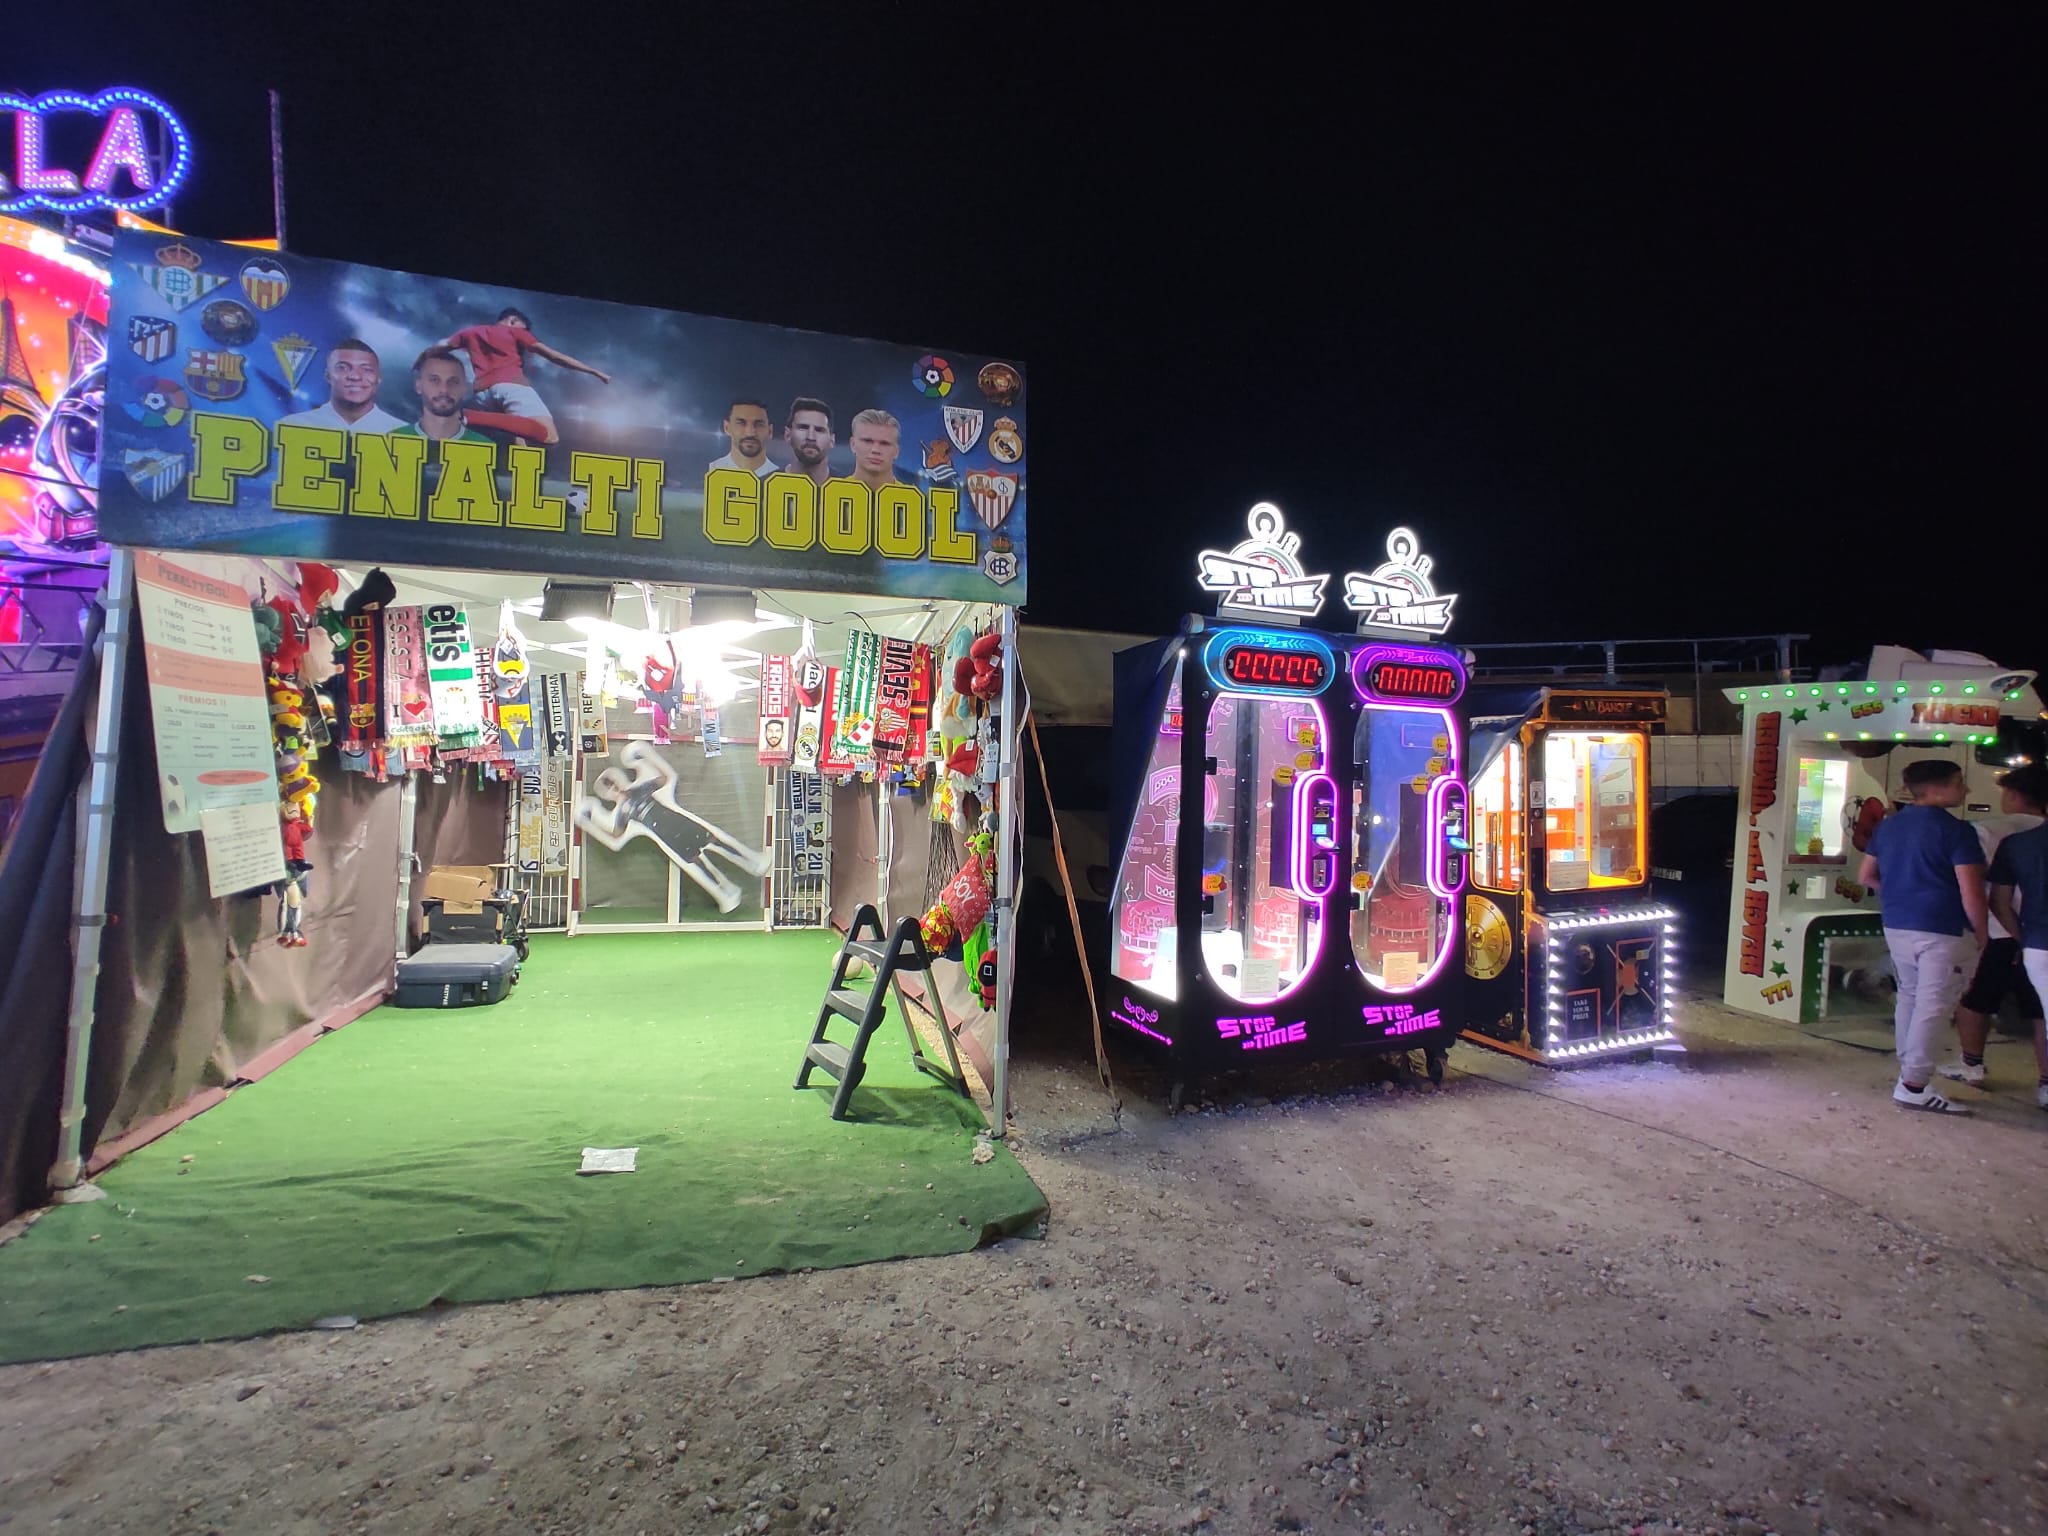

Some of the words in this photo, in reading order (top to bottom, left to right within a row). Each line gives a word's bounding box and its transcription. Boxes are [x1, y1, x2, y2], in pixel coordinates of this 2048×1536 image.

[188, 410, 665, 540] PENALTI
[702, 467, 978, 563] GOOOL
[768, 664, 783, 715] RAMOS
[1750, 711, 1781, 827] UMBER
[795, 831, 806, 852] JUDE
[808, 852, 823, 870] 20
[954, 875, 976, 904] SOY
[1740, 888, 1769, 978] REACH
[1216, 1017, 1275, 1038] STOP
[1363, 1005, 1413, 1025] STOP
[1395, 1009, 1440, 1035] TIME
[1254, 1021, 1307, 1049] TIME
